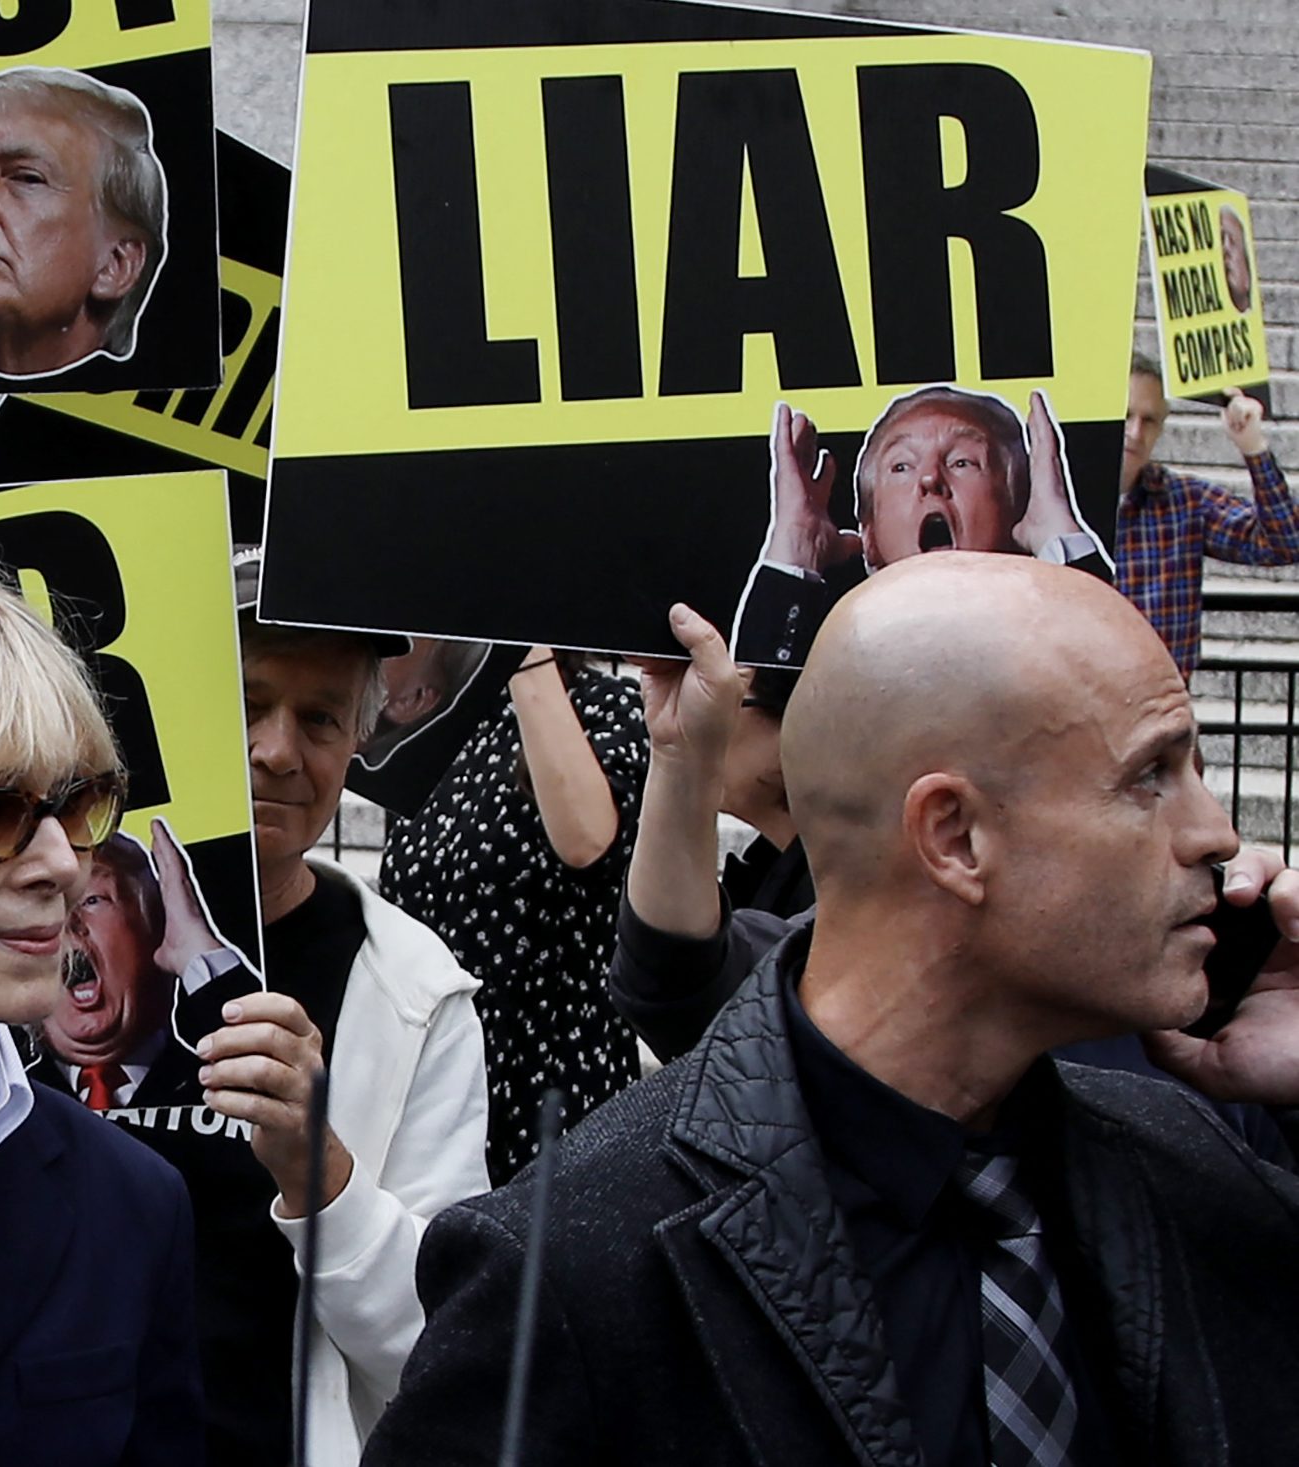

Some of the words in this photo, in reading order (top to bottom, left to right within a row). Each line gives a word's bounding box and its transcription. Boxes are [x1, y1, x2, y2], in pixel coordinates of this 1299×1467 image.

[388, 62, 1055, 410] LIAR
[1153, 204, 1189, 257] HAS
[1188, 201, 1214, 251] NO
[1163, 263, 1223, 320] MORAL
[1175, 320, 1253, 383] COMPASS
